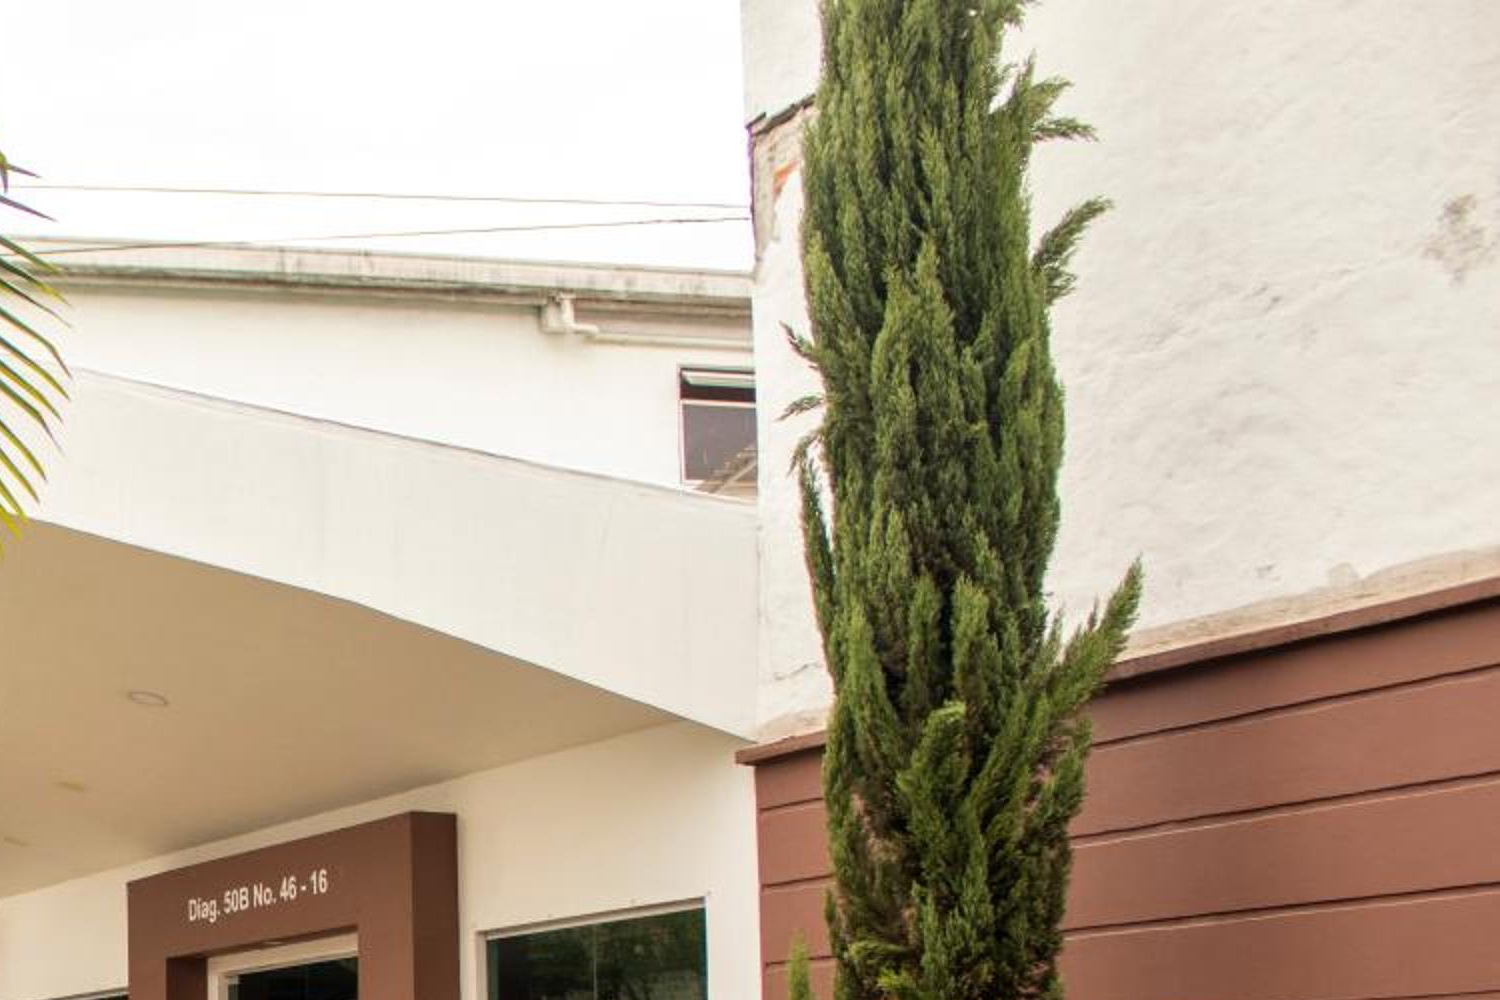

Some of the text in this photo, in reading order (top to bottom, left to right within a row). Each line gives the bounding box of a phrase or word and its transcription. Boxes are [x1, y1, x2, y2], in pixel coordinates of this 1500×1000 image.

[188, 898, 220, 923] Diag.
[224, 887, 249, 914] 50B
[253, 883, 276, 908] No.
[280, 875, 297, 901] 46
[310, 868, 328, 895] 16
